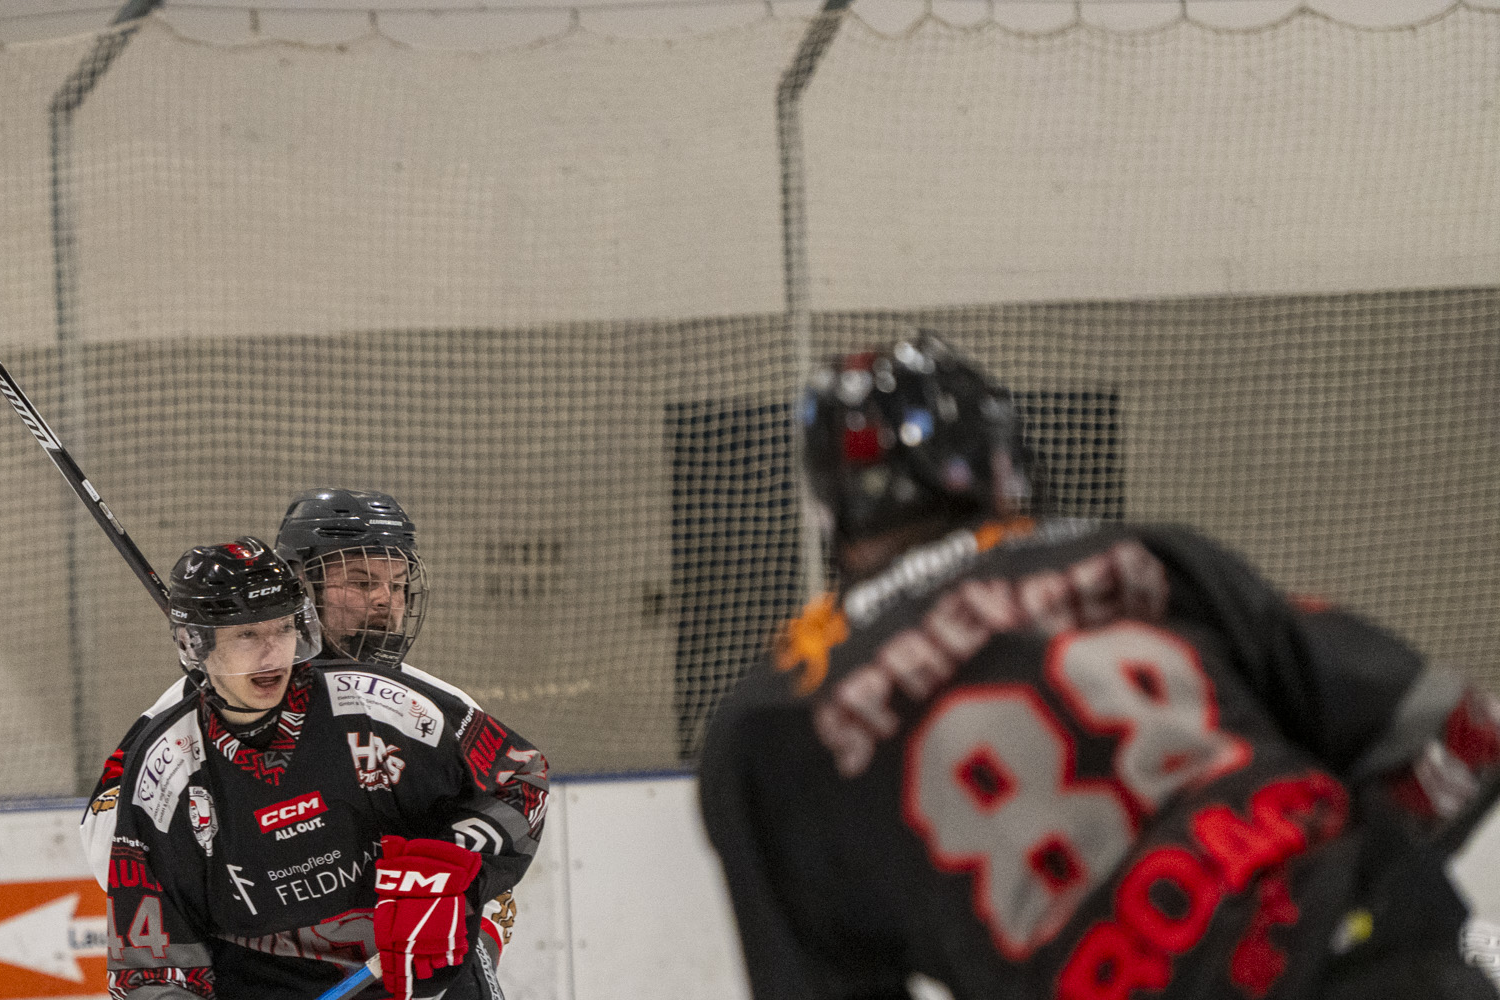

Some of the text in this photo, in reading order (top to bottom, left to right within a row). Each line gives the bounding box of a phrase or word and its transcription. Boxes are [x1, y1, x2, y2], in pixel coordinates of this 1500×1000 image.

[248, 585, 283, 599] CCM
[334, 673, 408, 704] SiTec
[902, 619, 1253, 962] 88
[261, 798, 319, 827] CCM
[276, 817, 326, 842] ALL OUT.
[267, 850, 342, 882] Baumpflege
[375, 869, 451, 893] CM
